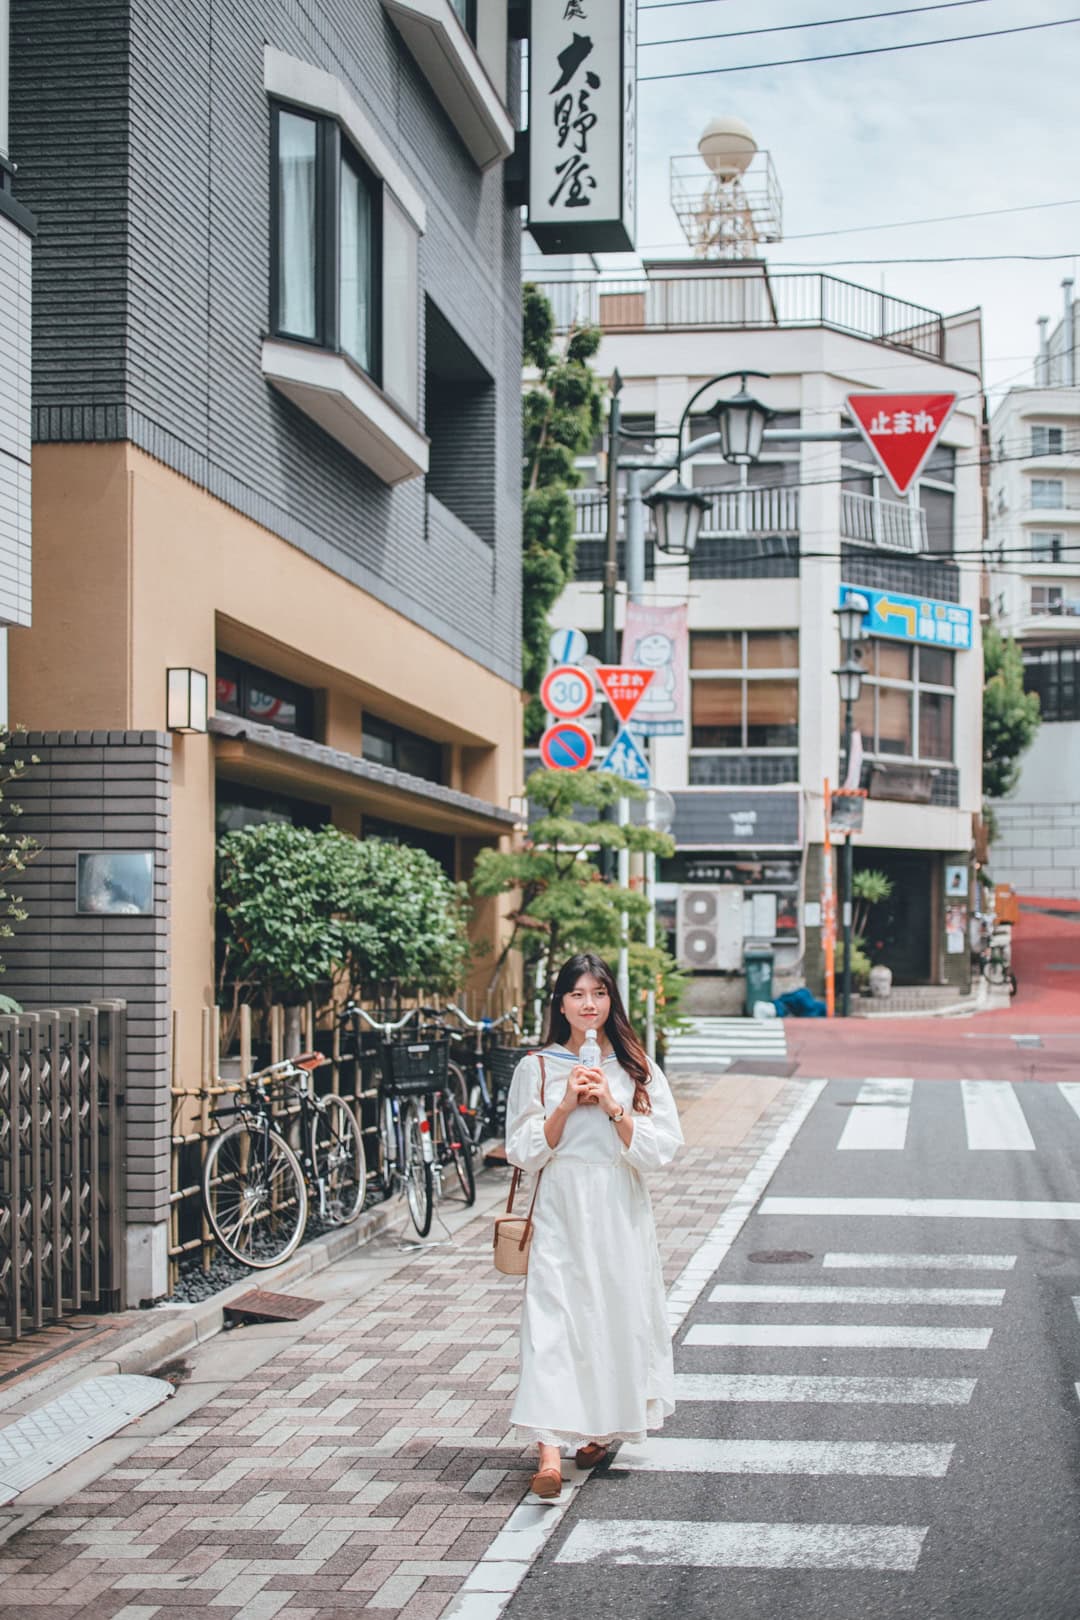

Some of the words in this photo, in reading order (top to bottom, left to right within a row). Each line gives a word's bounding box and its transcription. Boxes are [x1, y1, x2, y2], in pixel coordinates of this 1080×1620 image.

[548, 32, 601, 208] 大野屋
[869, 410, 937, 435] 止まれ
[606, 672, 645, 687] 止まれ
[554, 681, 583, 704] 30
[612, 687, 639, 700] STOP
